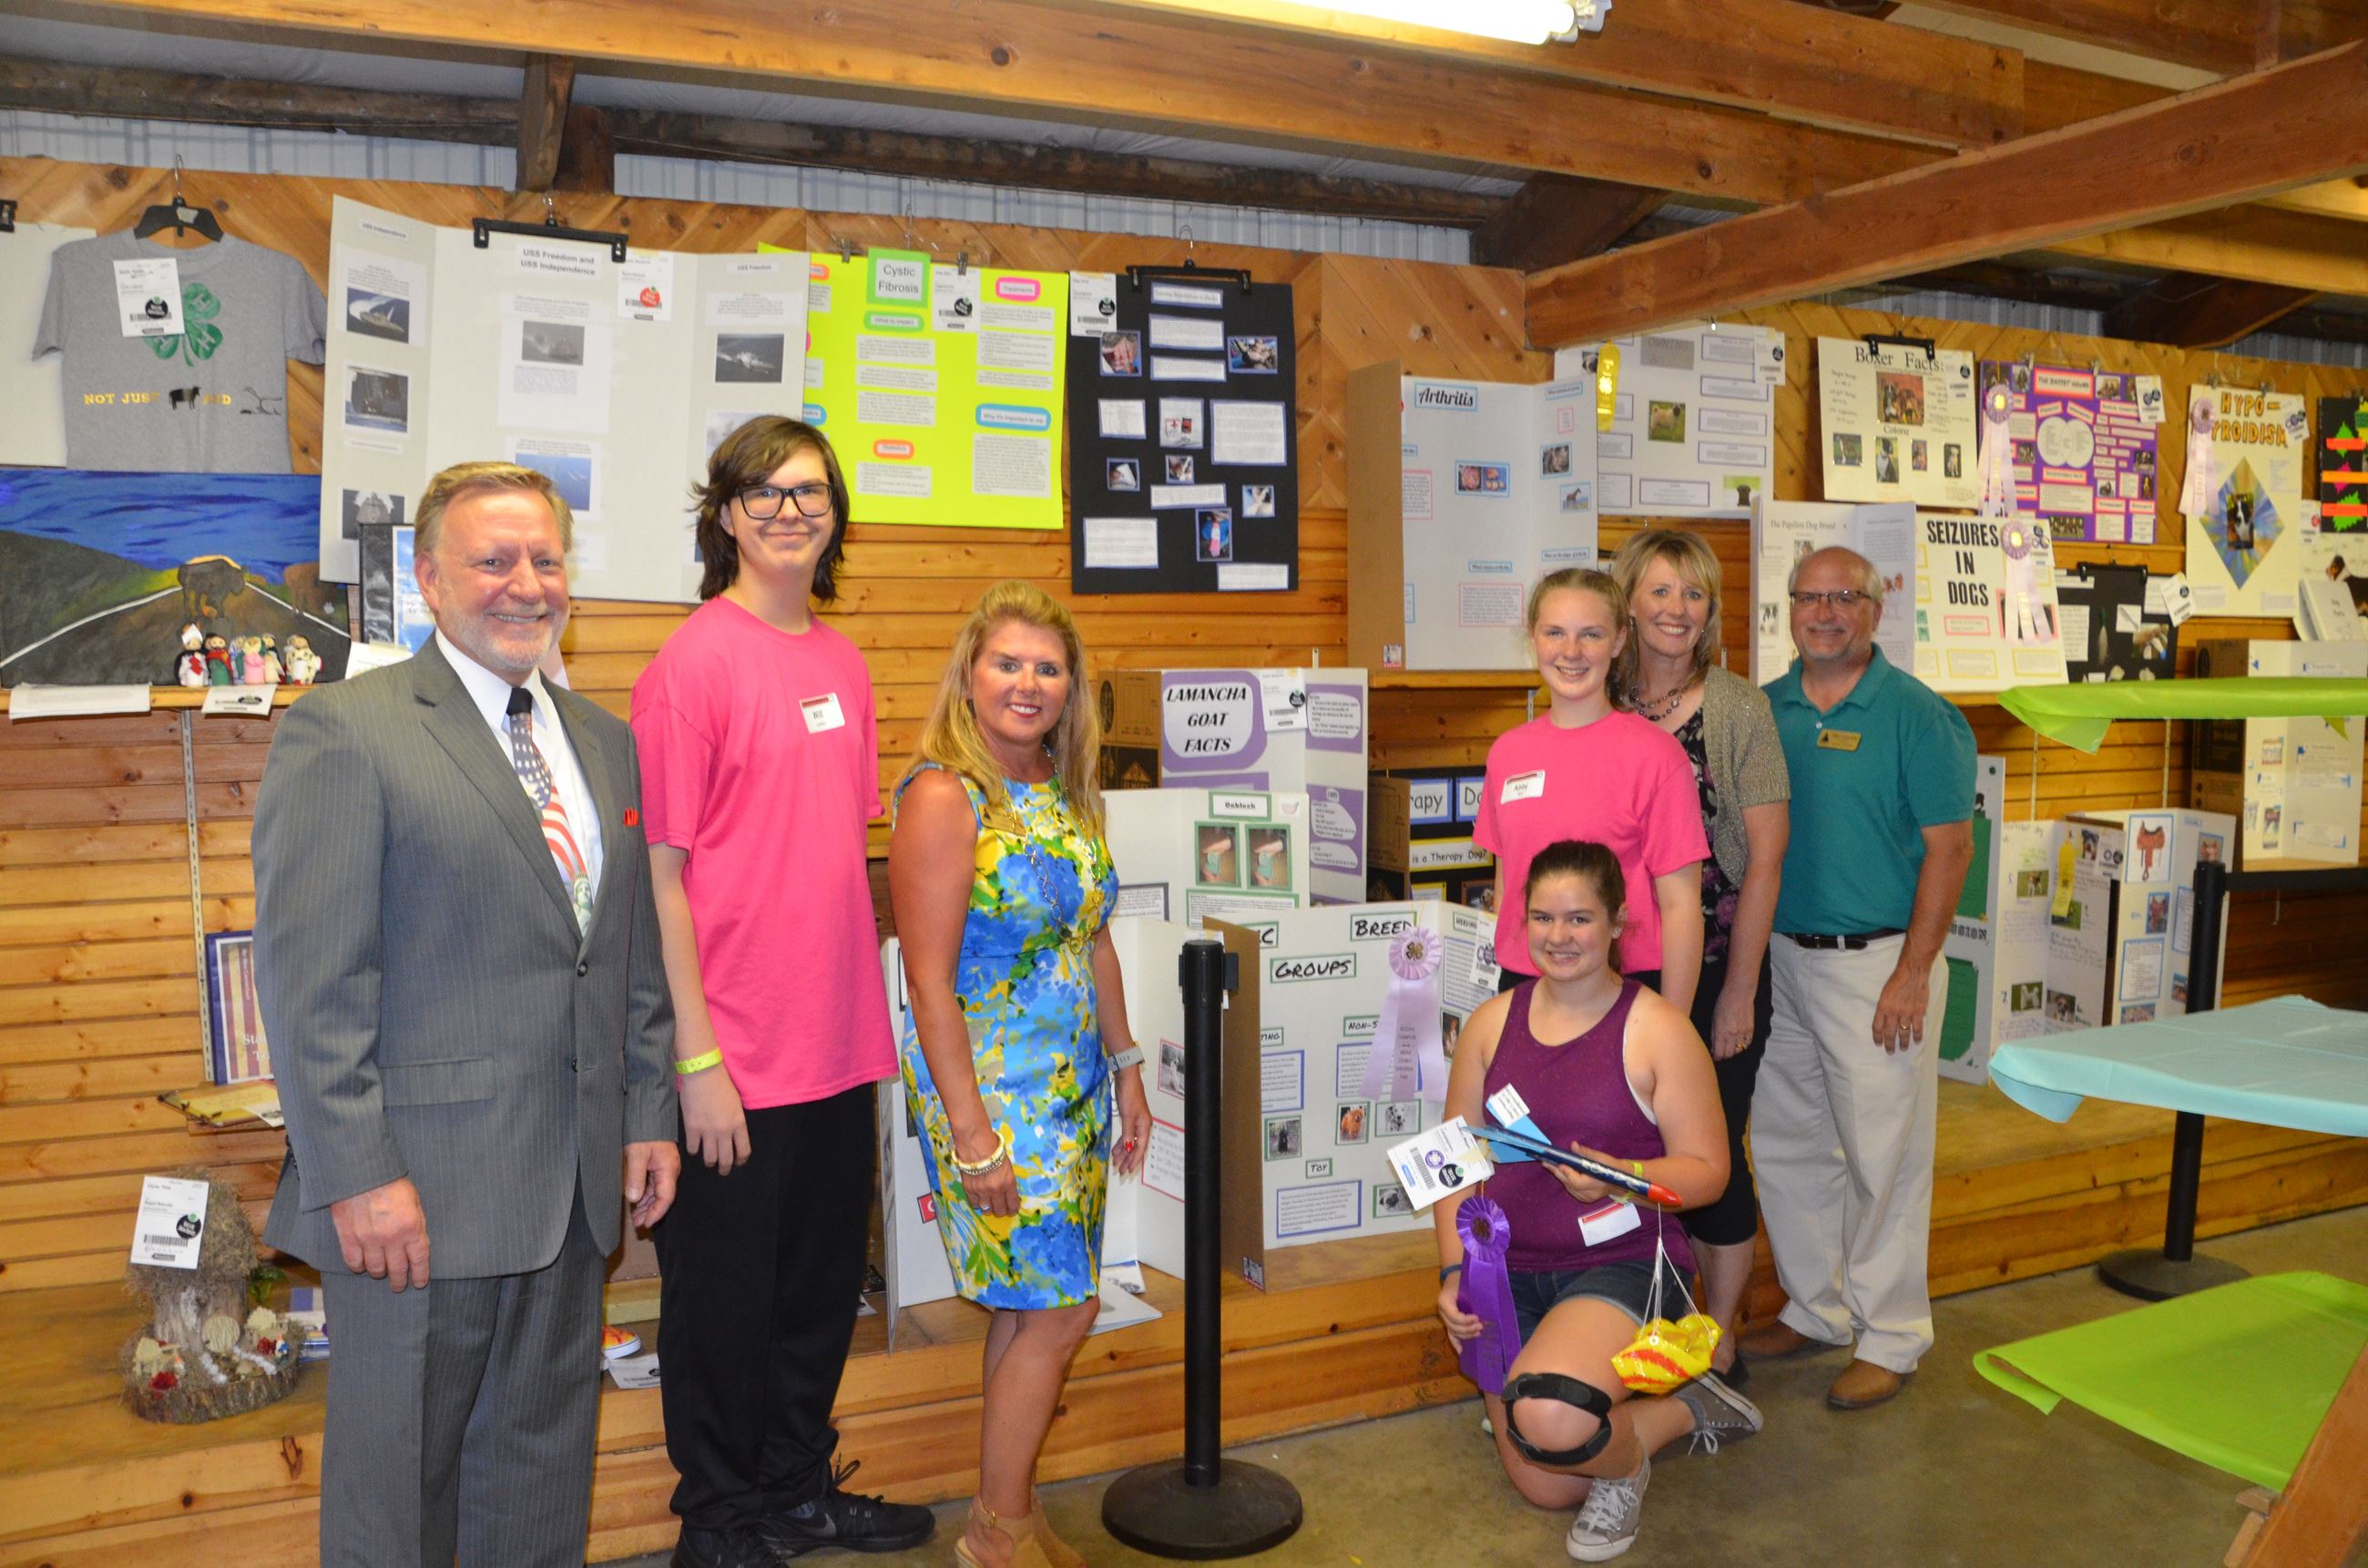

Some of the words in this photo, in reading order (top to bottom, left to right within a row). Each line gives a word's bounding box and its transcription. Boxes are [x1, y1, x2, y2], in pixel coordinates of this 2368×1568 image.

[523, 249, 540, 258] USS
[543, 251, 577, 263] Freedom
[579, 256, 595, 265] and
[521, 260, 537, 269] USS
[540, 262, 596, 276] Independence
[883, 264, 915, 279] Cystic
[878, 281, 919, 294] Fibrosis
[1855, 346, 1893, 365] Boxer
[84, 392, 116, 405] NOT
[120, 392, 160, 405] JUST
[1418, 387, 1474, 407] Arthritis
[1771, 520, 1781, 528] The
[1926, 520, 1999, 546] SEIZURES
[1955, 550, 1975, 575] IN
[1947, 581, 1989, 606] DOGS
[1167, 687, 1246, 702] LAMANCHA
[1188, 712, 1229, 727] GOAT
[1184, 738, 1231, 753] FACTS
[1413, 854, 1418, 862] is
[1430, 852, 1463, 863] Therapy
[1468, 849, 1487, 861] Dog?
[1275, 960, 1352, 979] GROUPS
[1349, 1021, 1379, 1030] NON-S
[242, 1034, 266, 1046] Sta
[1261, 1033, 1280, 1042] TING
[1312, 1164, 1327, 1173] TOY
